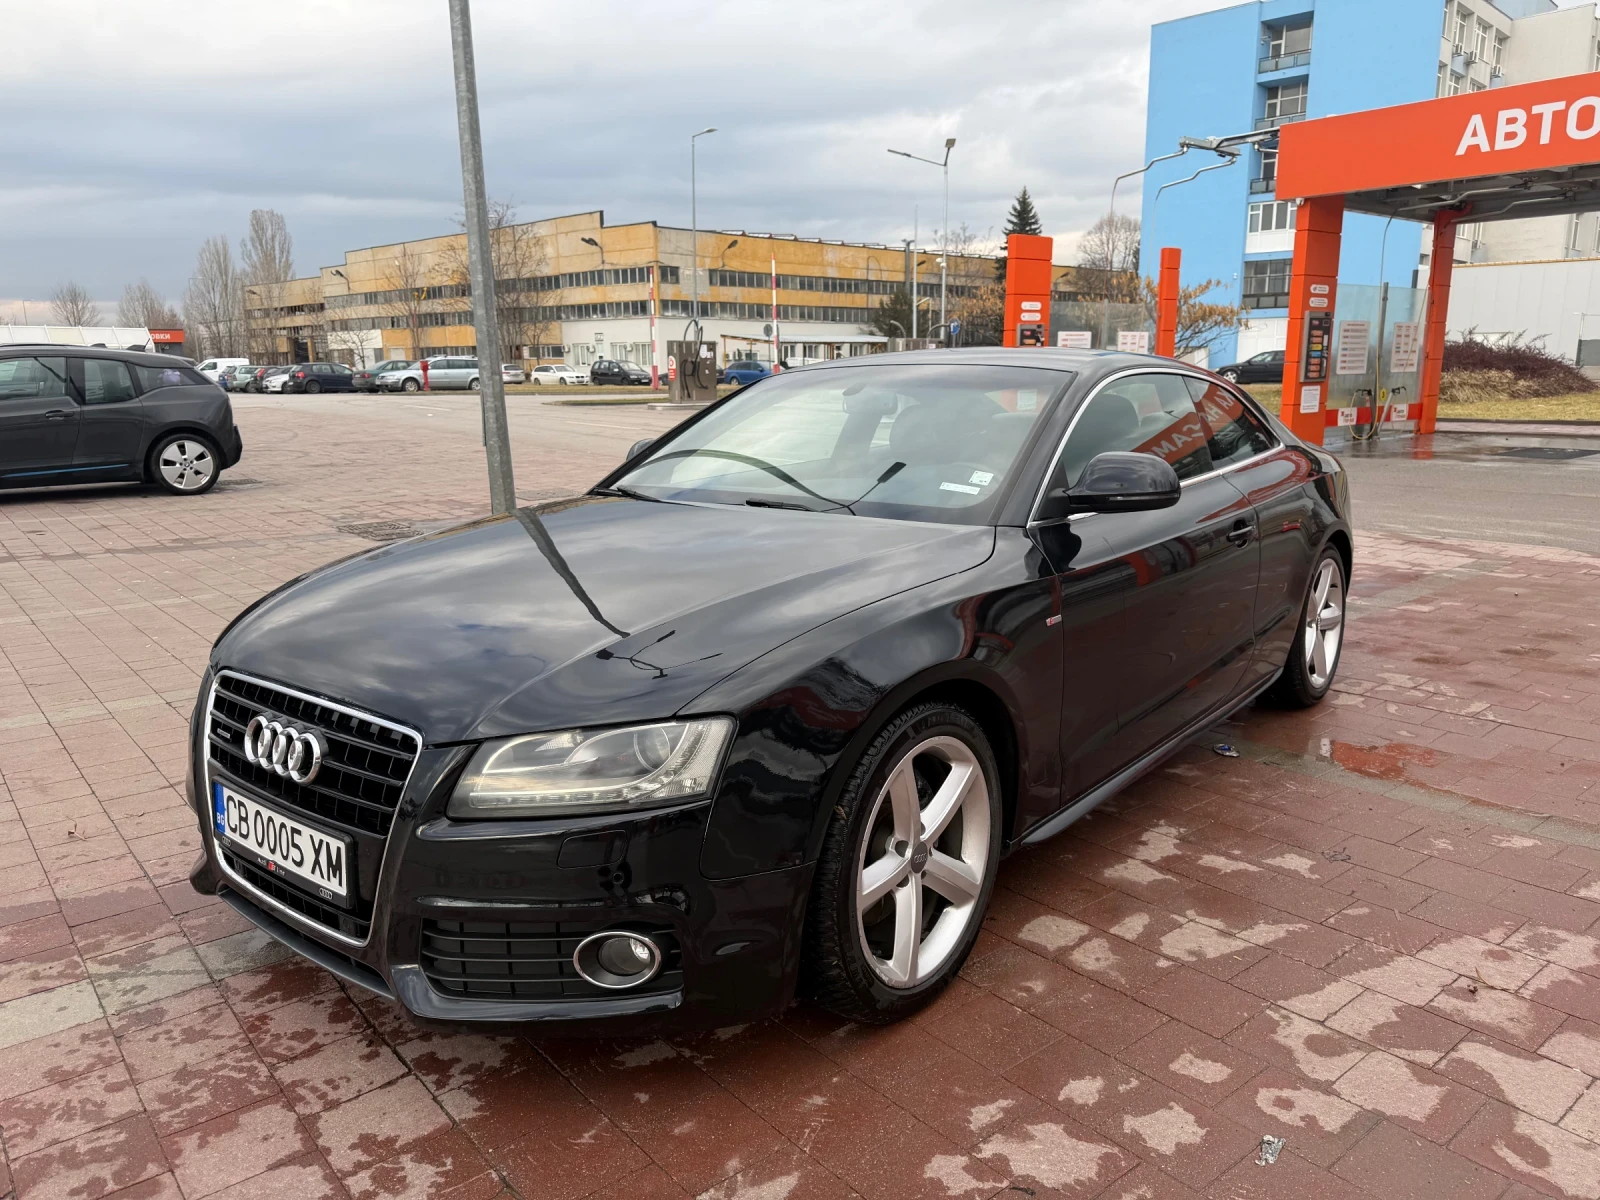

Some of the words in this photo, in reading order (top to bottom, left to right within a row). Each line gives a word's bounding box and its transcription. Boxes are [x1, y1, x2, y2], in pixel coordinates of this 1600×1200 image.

[1455, 96, 1600, 156] АВТО
[216, 812, 225, 826] BG
[226, 795, 250, 840] CB
[254, 809, 304, 868] 0005
[309, 833, 343, 888] XM
